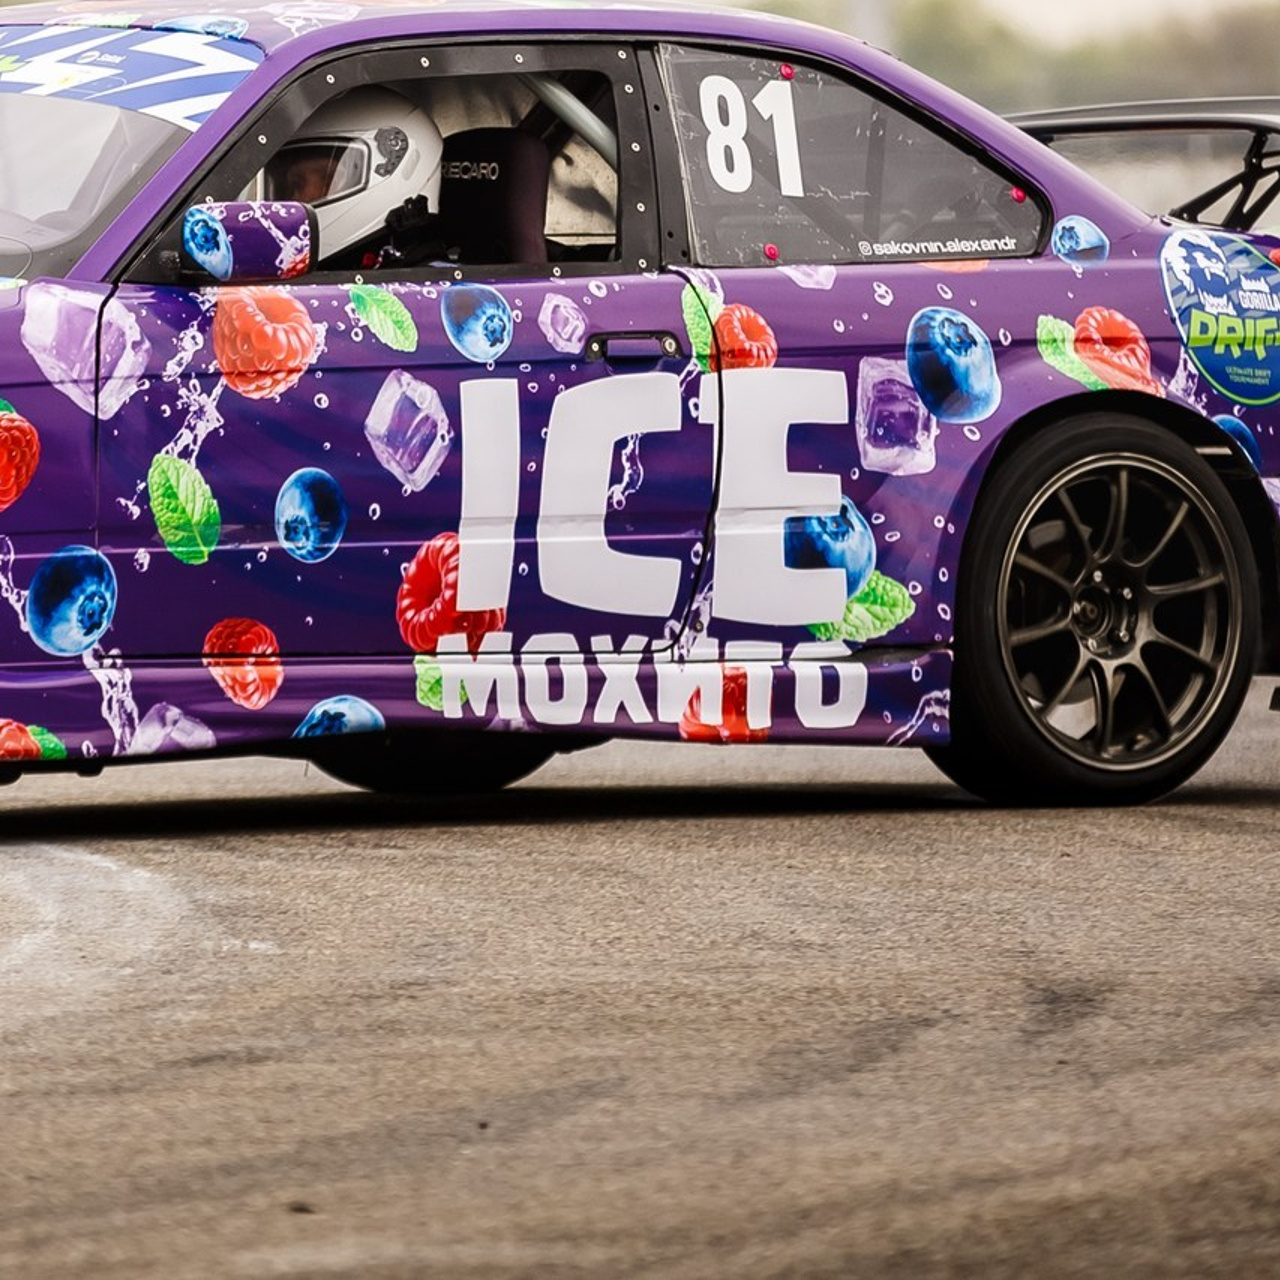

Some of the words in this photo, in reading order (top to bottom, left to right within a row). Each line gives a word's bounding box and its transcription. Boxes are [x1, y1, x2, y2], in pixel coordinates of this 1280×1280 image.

[699, 75, 804, 197] 81
[1188, 308, 1280, 361] DRIF
[456, 368, 849, 626] ICE
[437, 632, 868, 729] МОХИТО
